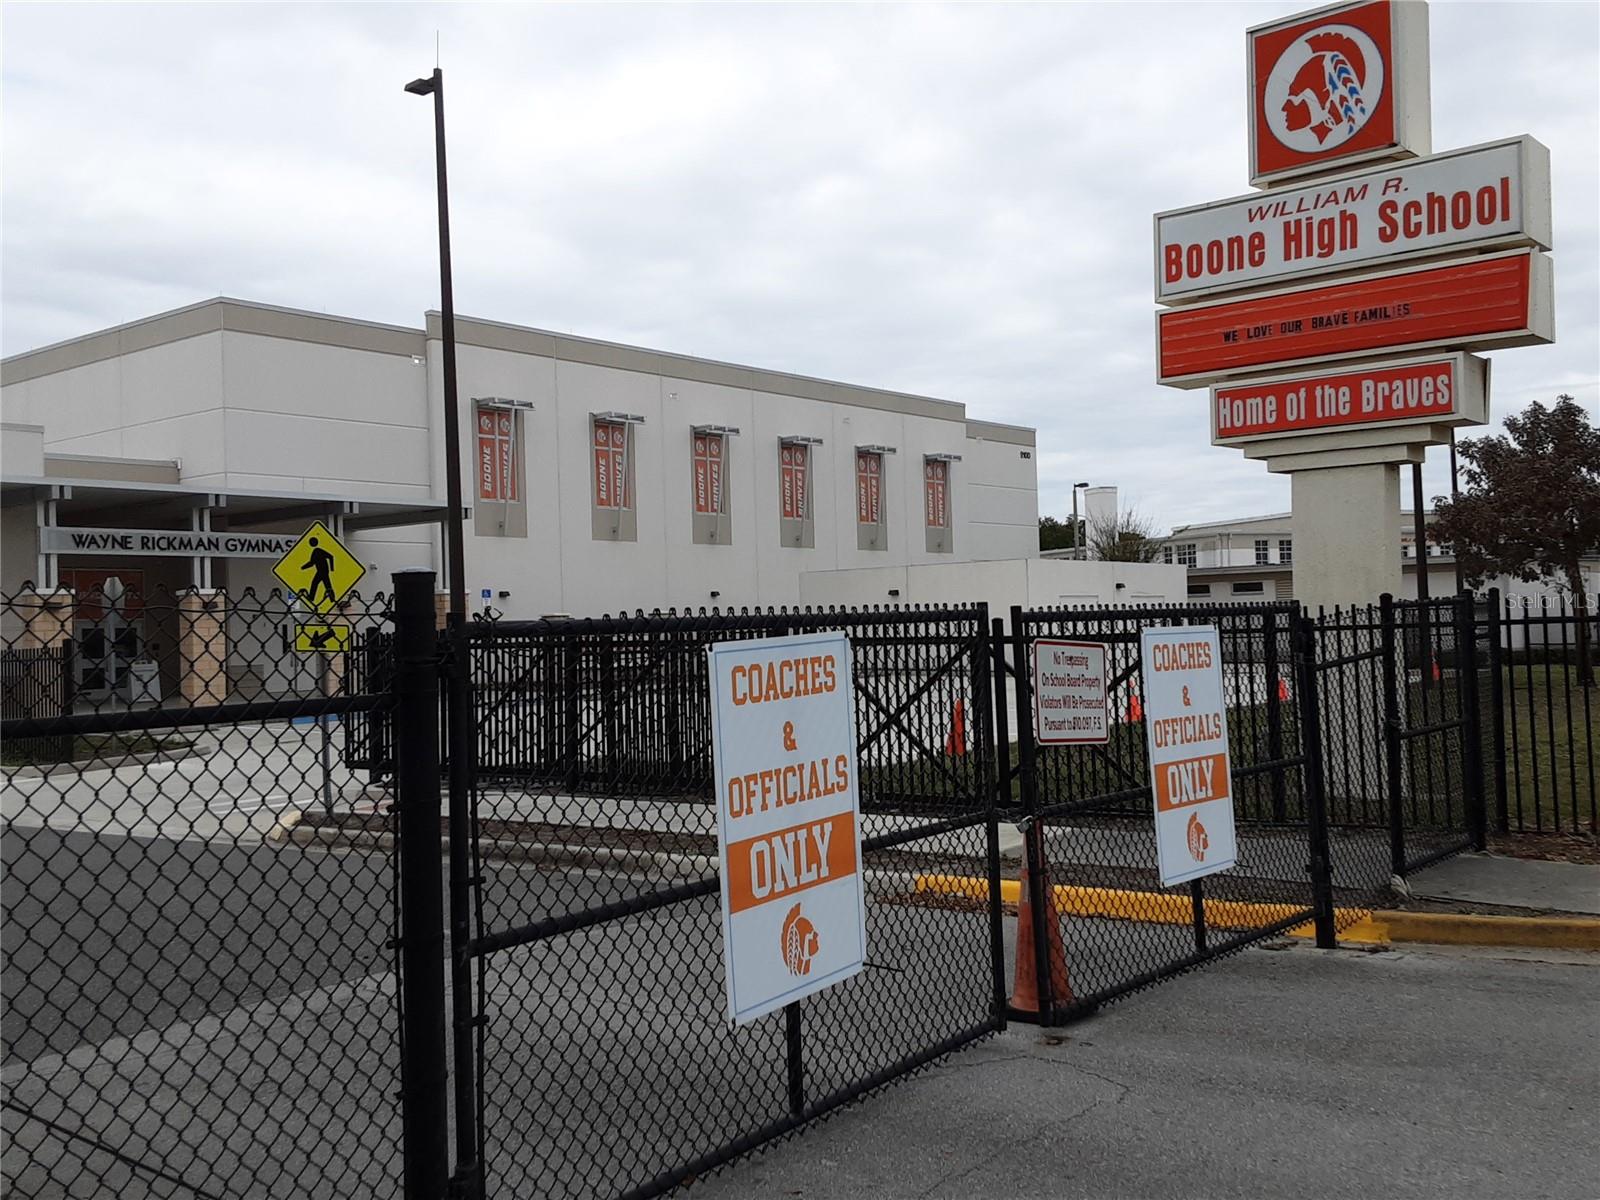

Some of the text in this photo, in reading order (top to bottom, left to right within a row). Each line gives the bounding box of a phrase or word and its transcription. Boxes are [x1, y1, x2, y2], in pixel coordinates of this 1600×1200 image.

[1246, 177, 1409, 223] WILLIAM R.
[1165, 177, 1510, 284] Boone High School
[1222, 303, 1411, 343] WE LOVE OUR BRAVE FAMILIES
[1218, 372, 1450, 429] Home of the Braves
[483, 444, 492, 492] BOONE
[599, 456, 607, 500] BOONE
[697, 465, 705, 506] BOONE
[71, 533, 297, 553] WAYNE RICKMAN GYMNAS
[1053, 651, 1061, 665] No
[1153, 641, 1212, 672] COACHES
[731, 654, 837, 706] COACHES
[1042, 672, 1102, 690] On School Board Property
[1182, 685, 1192, 706] &
[1040, 694, 1104, 709] Violators Will Be Prosecuted
[782, 720, 797, 752] &
[1044, 716, 1066, 731] Pursuant
[1067, 717, 1073, 731] to
[1153, 713, 1221, 748] OFFICIALS
[728, 754, 849, 819] OFFICIALS
[1167, 758, 1214, 805] ONLY
[749, 821, 832, 899] ONLY
